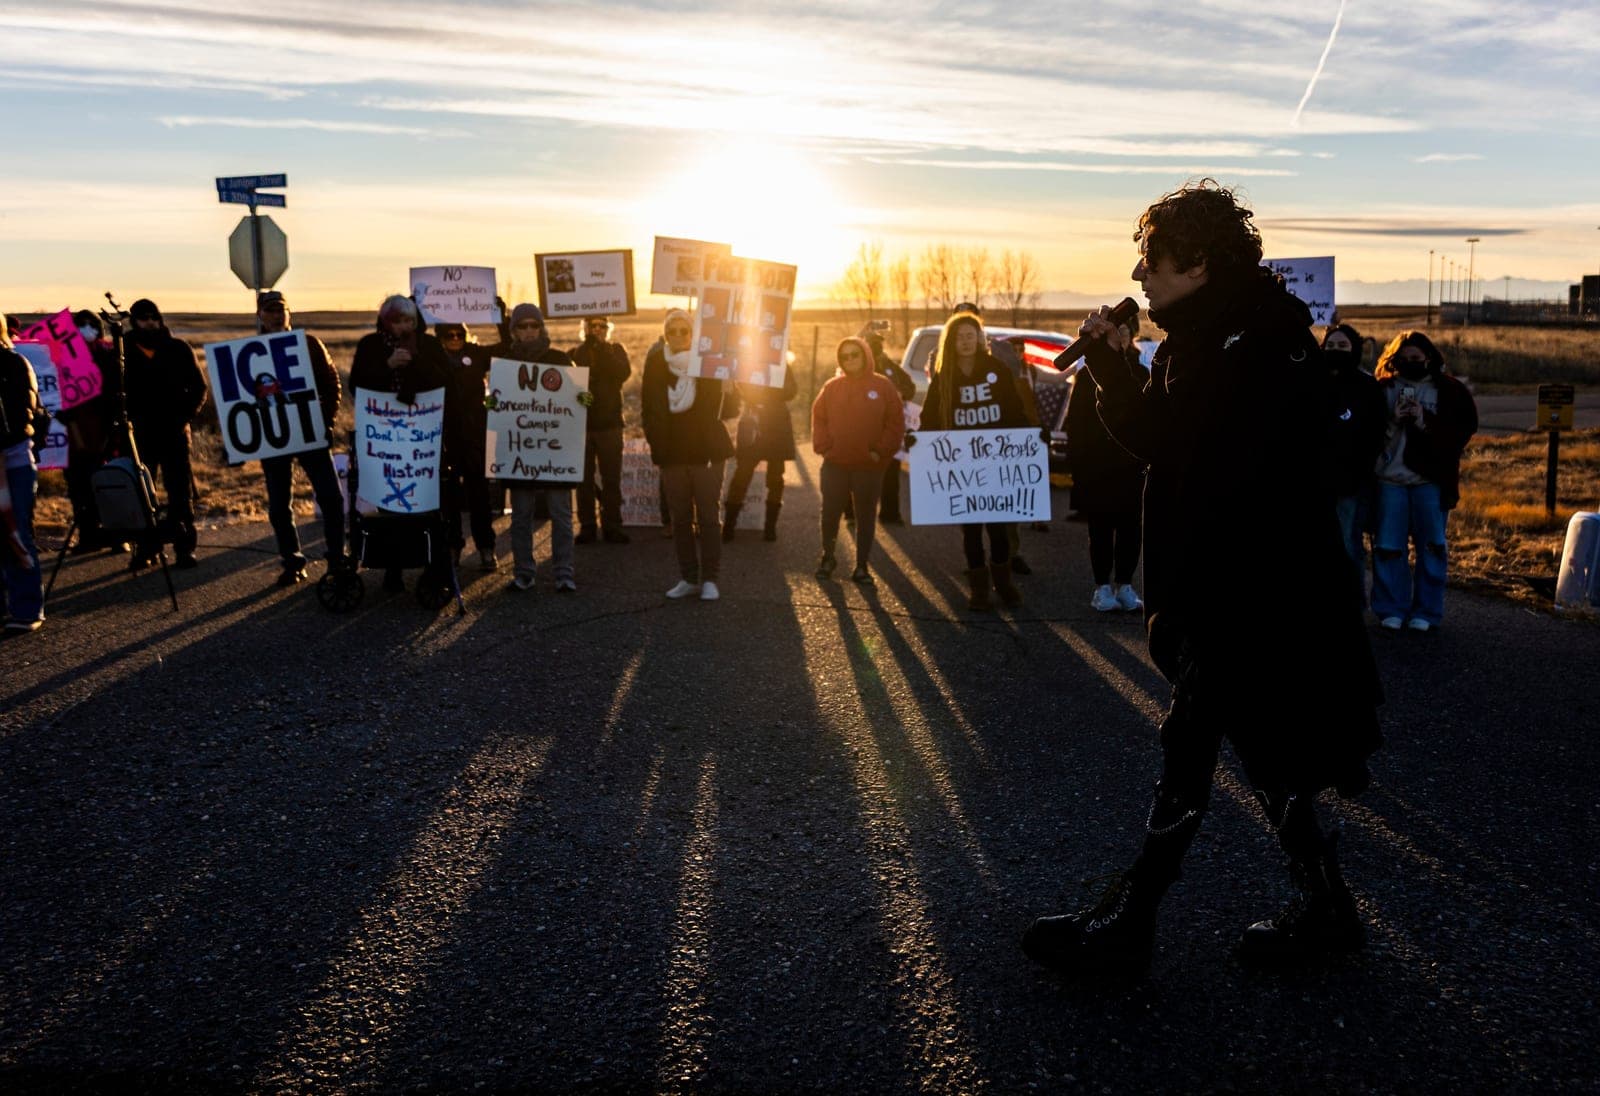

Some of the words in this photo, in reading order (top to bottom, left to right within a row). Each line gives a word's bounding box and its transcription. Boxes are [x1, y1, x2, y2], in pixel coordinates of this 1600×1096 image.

[1304, 271, 1315, 284] is
[553, 302, 579, 313] Snap
[580, 300, 598, 310] out
[600, 299, 610, 309] of
[213, 334, 307, 403] ICE
[518, 363, 563, 392] NO
[492, 388, 574, 417] Concentration
[959, 382, 993, 404] BE
[227, 388, 317, 455] OUT
[516, 414, 560, 433] Camps
[953, 403, 1001, 427] GOOD
[508, 430, 562, 453] Here
[930, 433, 962, 463] We
[969, 434, 993, 461] the
[383, 463, 434, 480] History
[489, 462, 506, 474] or
[512, 456, 578, 481] Anywhere
[927, 466, 989, 495] HAVE
[999, 463, 1043, 488] HAD
[949, 487, 1036, 518] ENOUGH!!!
